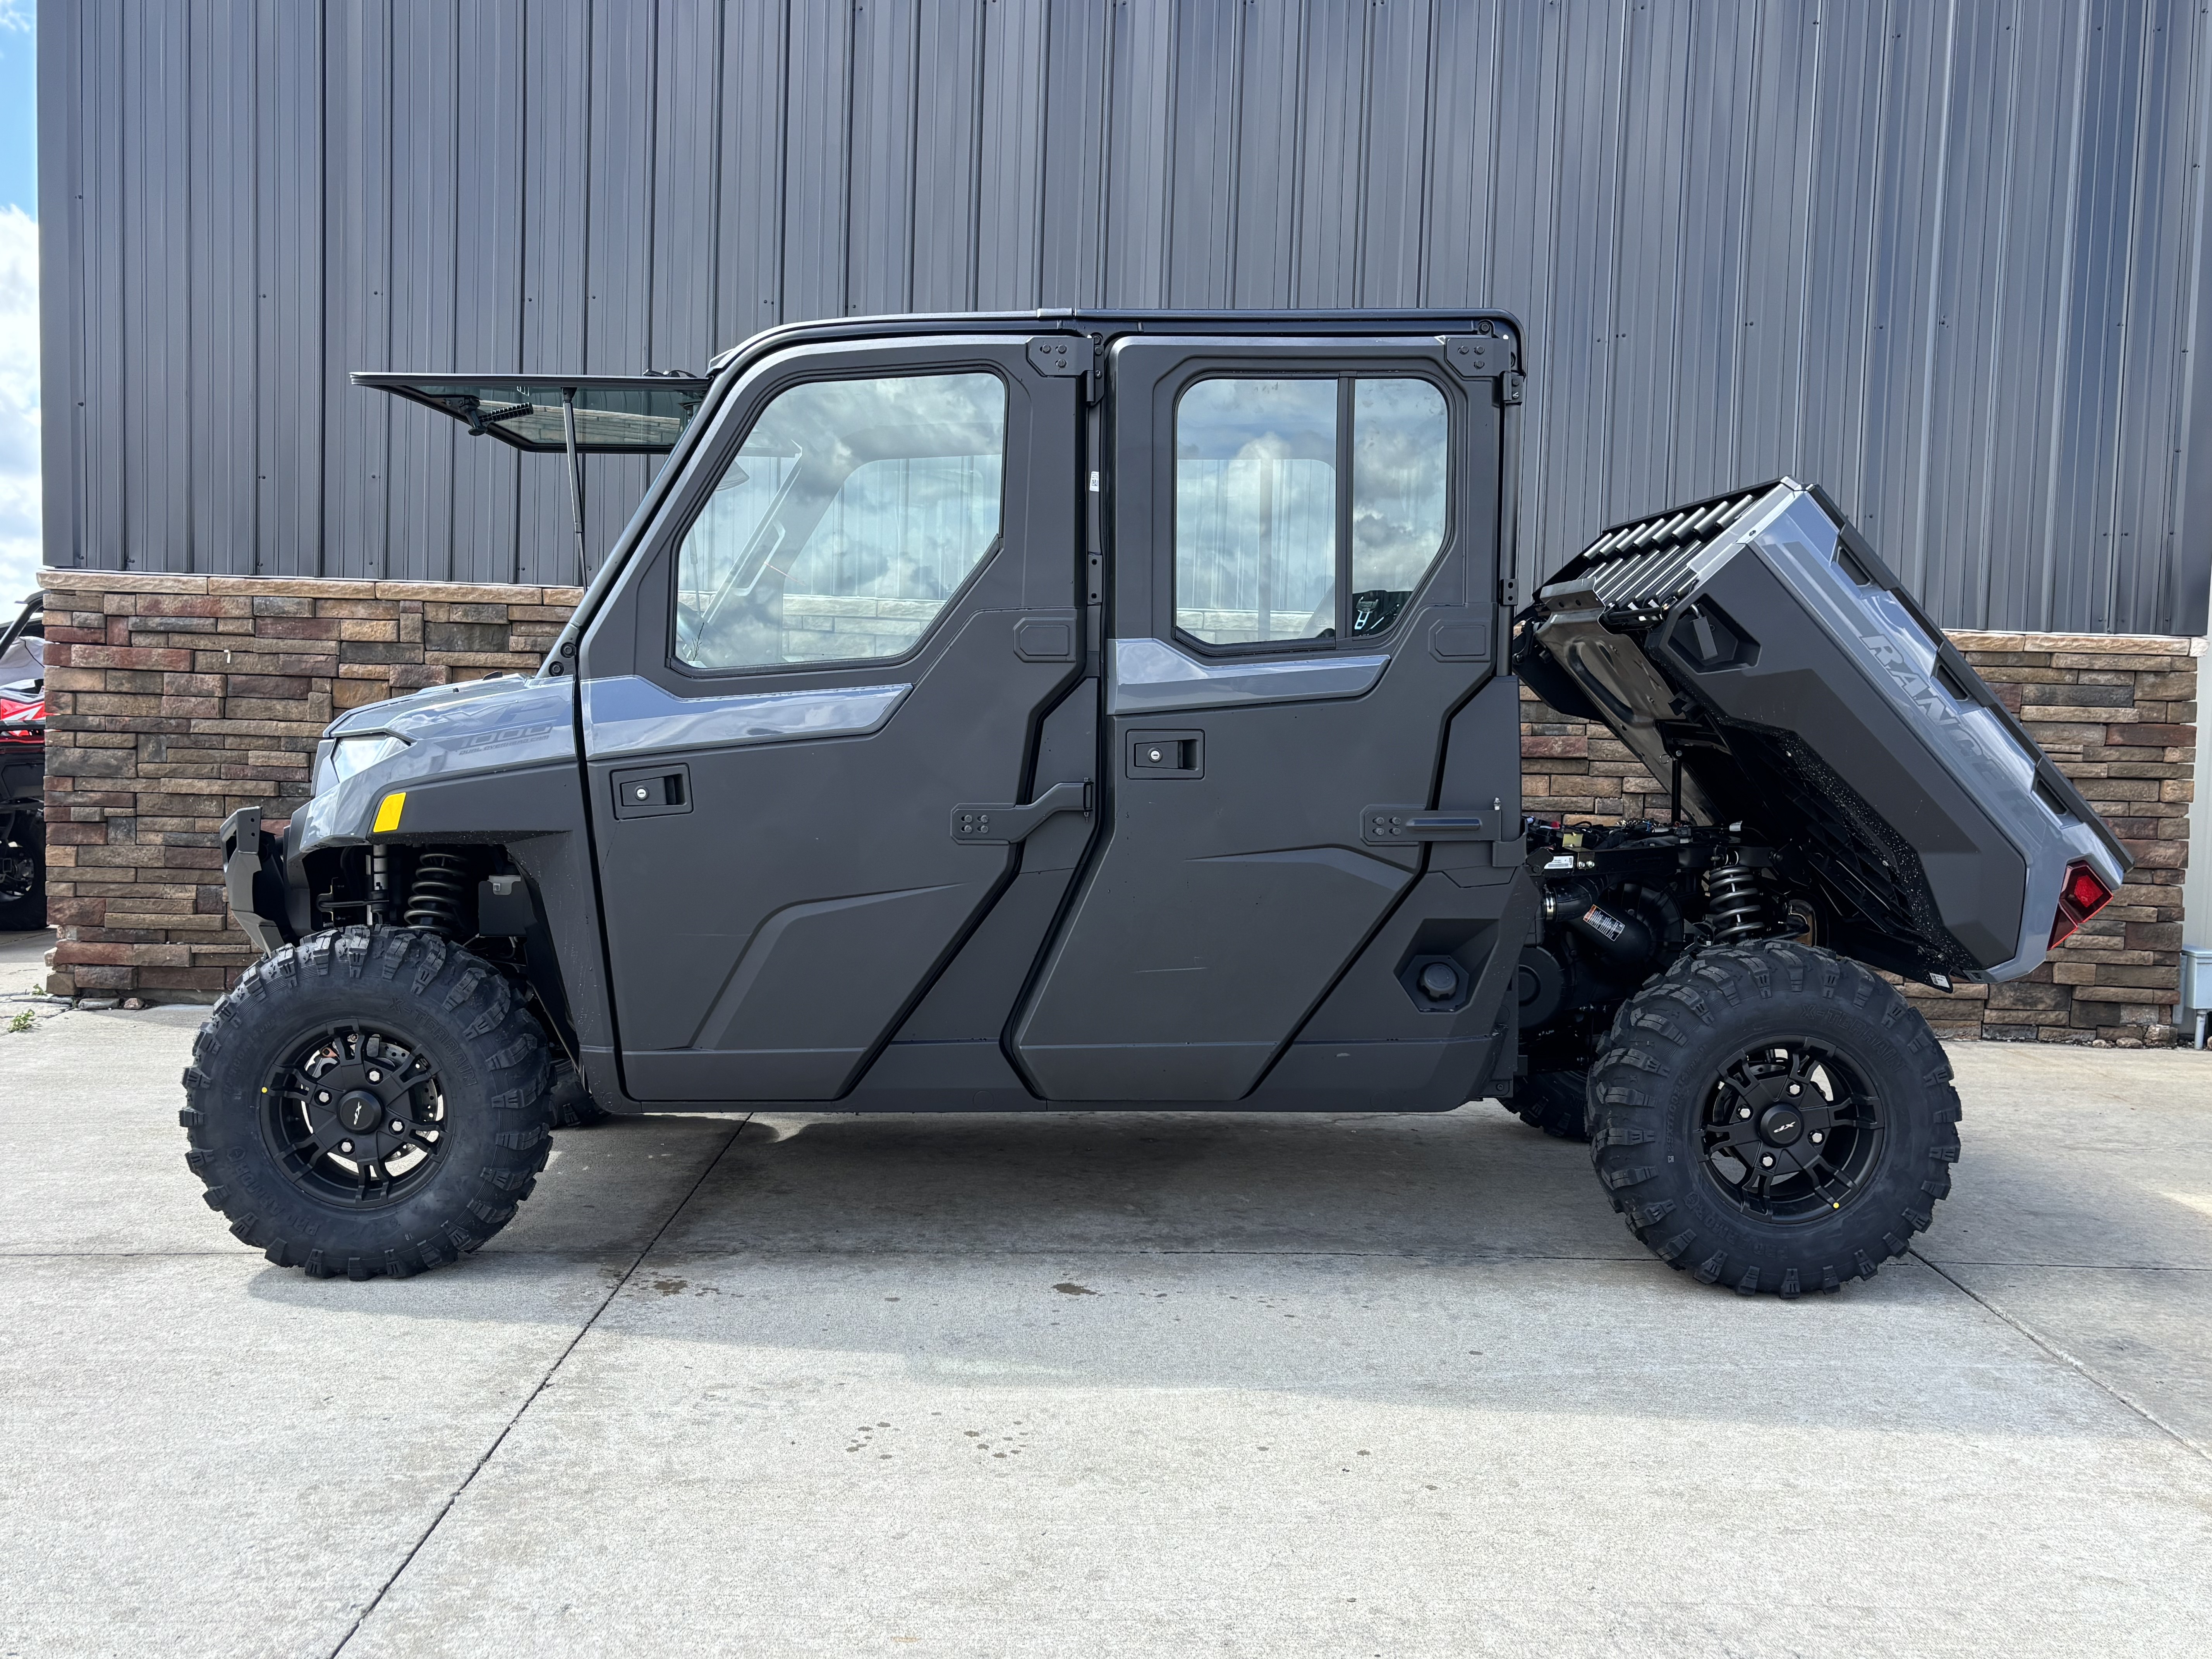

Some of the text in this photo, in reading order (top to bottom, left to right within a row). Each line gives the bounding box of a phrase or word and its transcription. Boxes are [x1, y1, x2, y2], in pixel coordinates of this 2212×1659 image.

[460, 725, 552, 747] 1000
[484, 740, 529, 750] OVERHEAD
[1861, 634, 2036, 822] RANGER
[388, 997, 477, 1086] X-TERRAIN
[1801, 1004, 1905, 1072] X-TERRAIN
[1774, 1121, 1796, 1133] XP
[235, 1164, 320, 1236] PRO ARMOR
